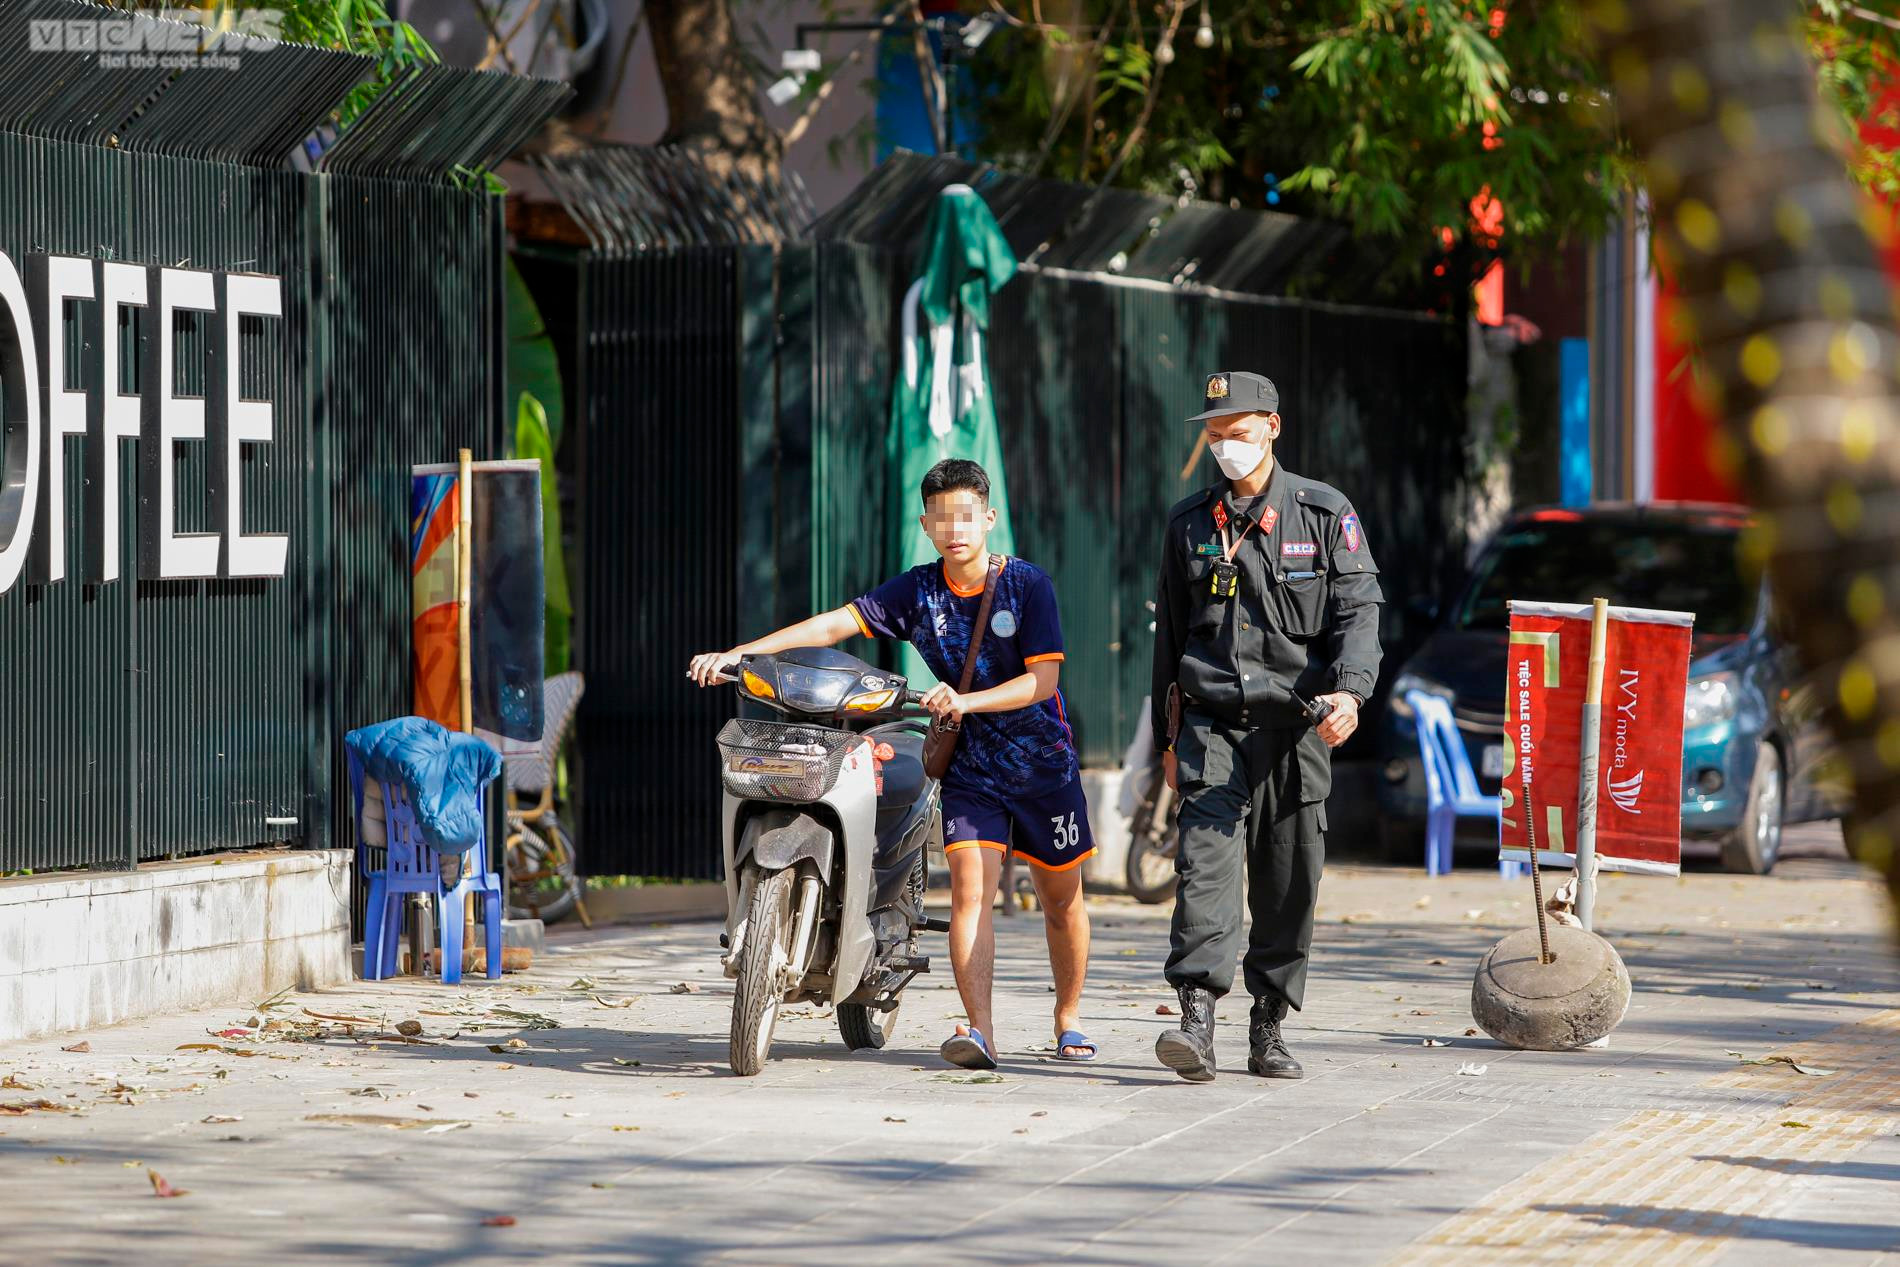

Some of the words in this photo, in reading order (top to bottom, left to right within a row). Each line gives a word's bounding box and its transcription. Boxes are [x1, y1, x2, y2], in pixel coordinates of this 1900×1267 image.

[1517, 660, 1531, 688] TIỆC
[1519, 690, 1530, 721] SALE
[1617, 669, 1639, 720] IVY
[1520, 723, 1534, 754] CUỐI
[1614, 719, 1628, 768] moda
[1521, 756, 1534, 784] NĂM
[1051, 811, 1079, 850] 36
